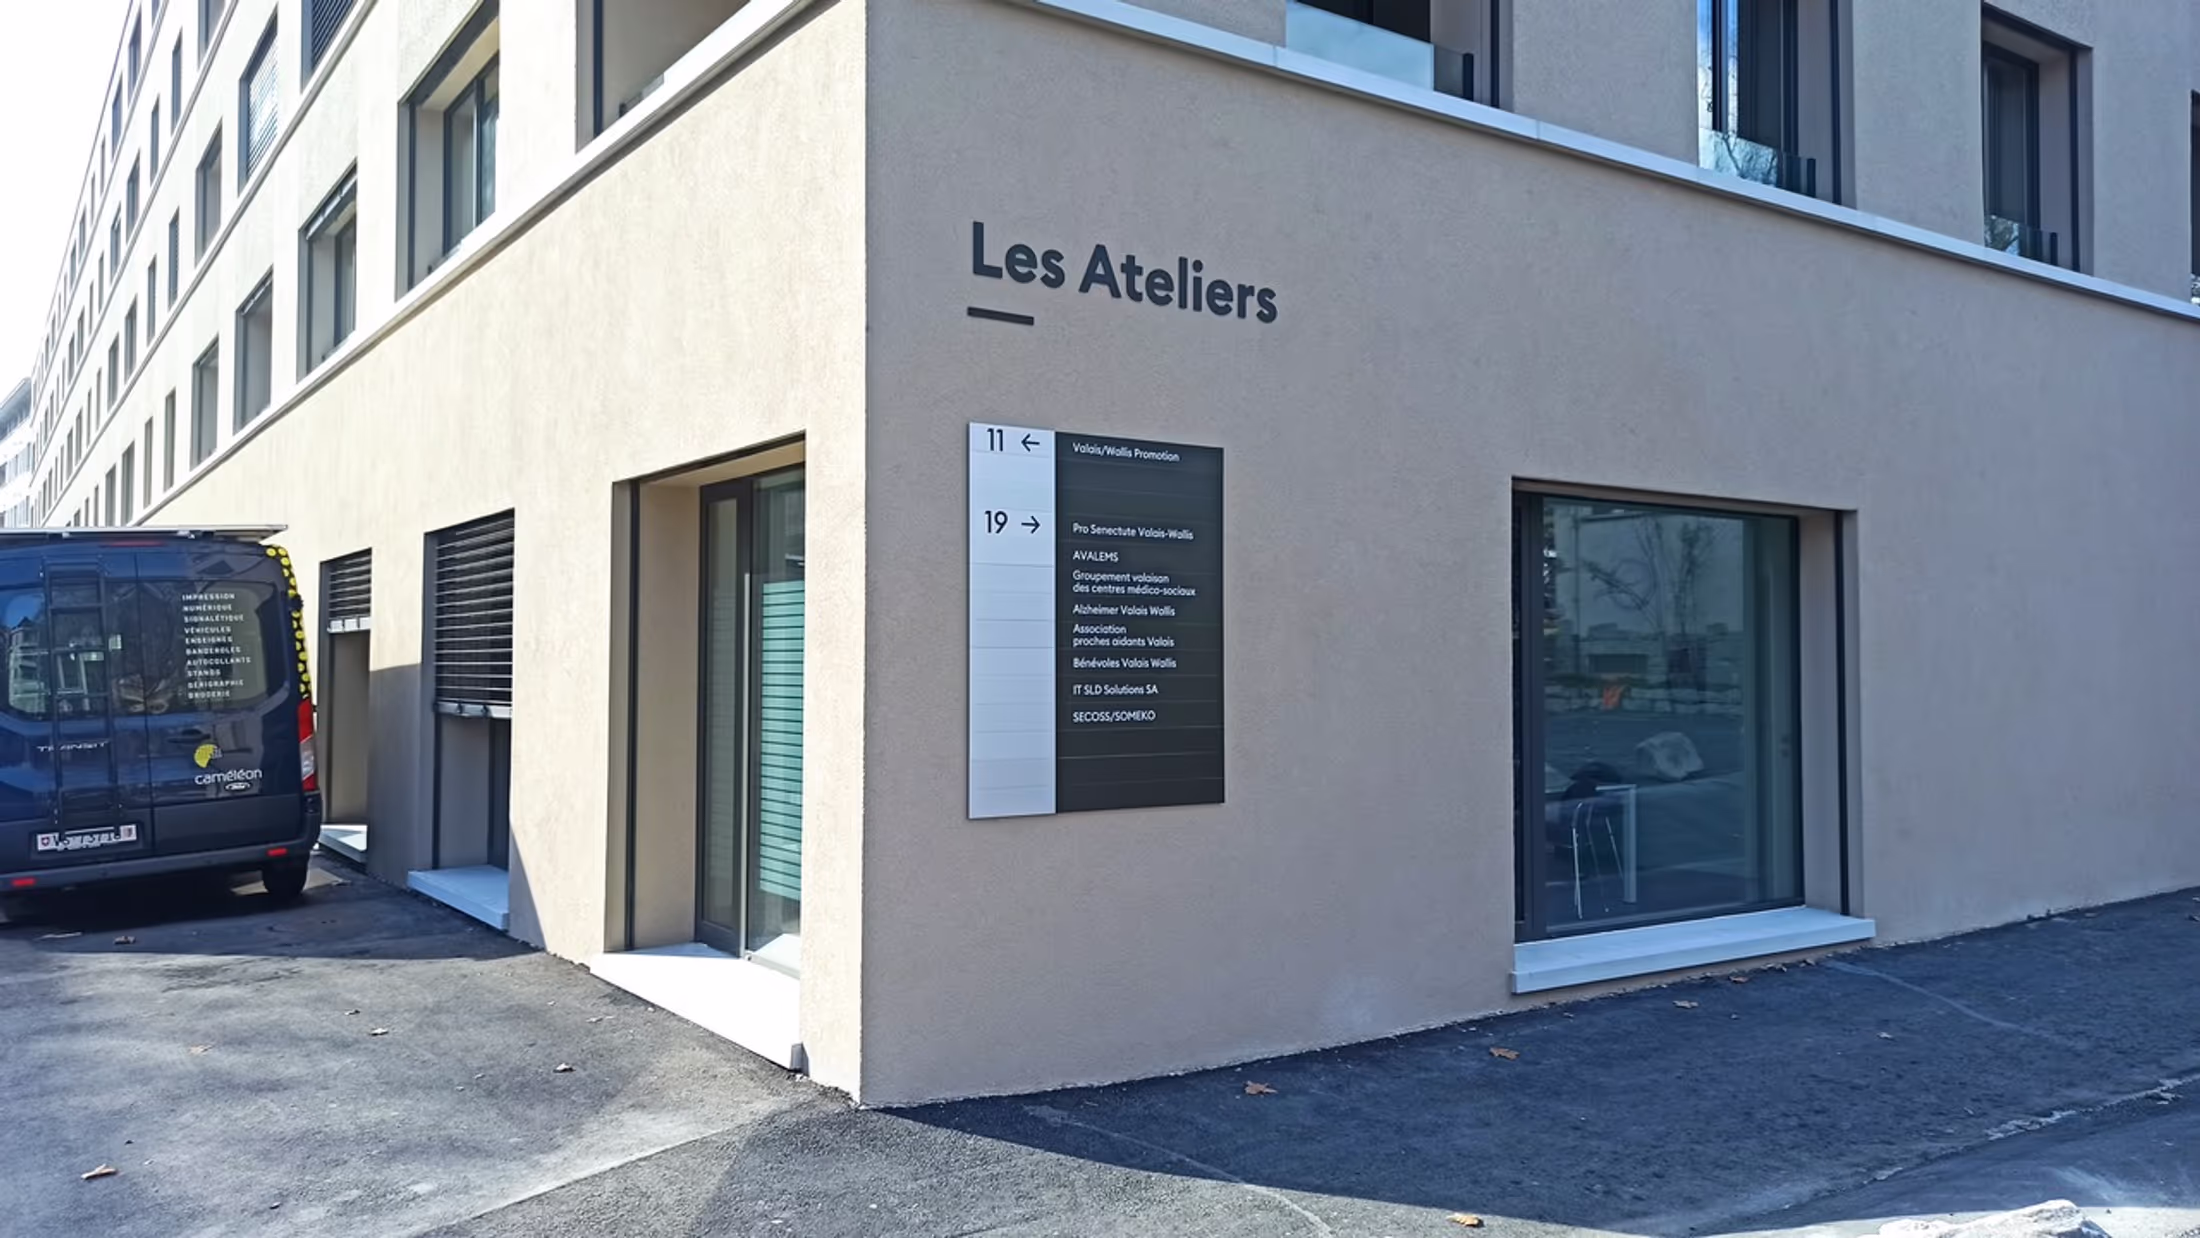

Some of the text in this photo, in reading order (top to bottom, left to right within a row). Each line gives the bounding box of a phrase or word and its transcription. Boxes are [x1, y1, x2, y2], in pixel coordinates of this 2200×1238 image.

[972, 220, 1278, 324] Les Ateliers
[987, 428, 1004, 452] 11
[1072, 442, 1180, 462] Valais/Wallis Promotion
[984, 510, 1008, 534] 19
[1072, 522, 1194, 540] Pro Senectute Valais-Wallis
[1072, 550, 1119, 562] AVALEMS
[1072, 570, 1131, 583] Groupement
[1072, 582, 1196, 596] des centres médico-sociaux
[182, 593, 235, 601] IMPRESSION
[1072, 604, 1176, 616] Alzheimer Valais Wallis
[1072, 624, 1127, 634] Association
[1072, 636, 1175, 648] proches aidants Valais
[1072, 657, 1177, 668] Bénévoles Valais Wallis
[1072, 684, 1159, 695] IT SLD Solutions SA
[1072, 710, 1156, 722] SECOSS/SOMEKO
[194, 768, 263, 785] caméléon
